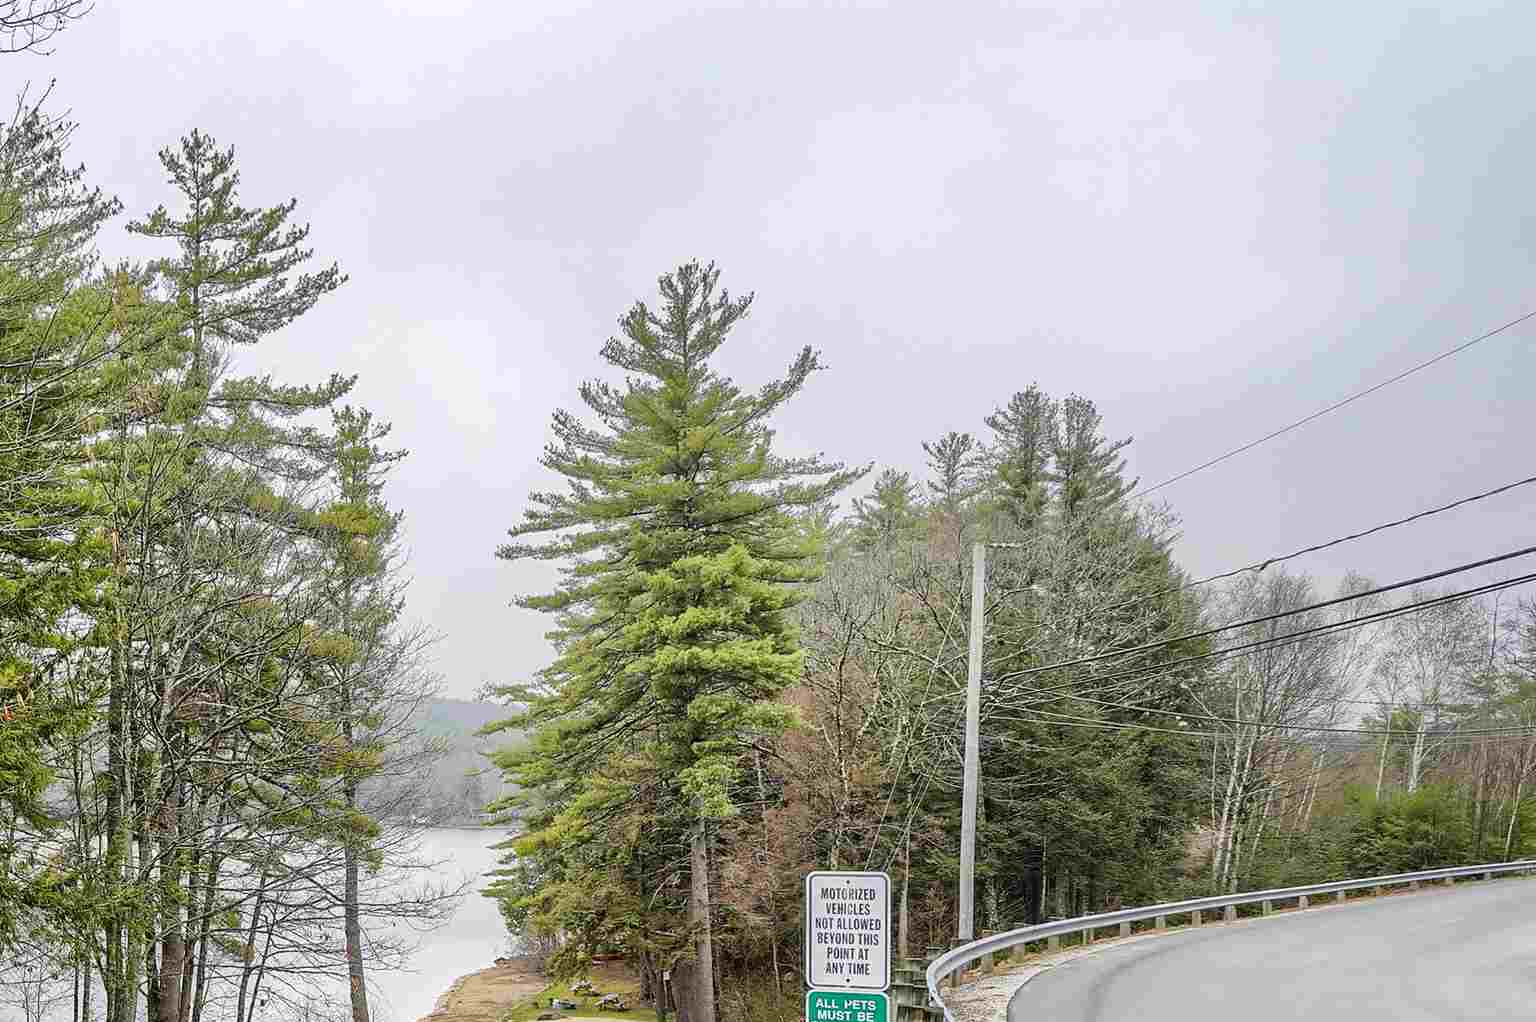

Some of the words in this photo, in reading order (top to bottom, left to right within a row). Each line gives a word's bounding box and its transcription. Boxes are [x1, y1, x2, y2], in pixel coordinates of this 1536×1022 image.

[820, 888, 876, 900] MOTORIZED
[826, 903, 871, 915] VEHICLES
[815, 918, 834, 929] NOT
[837, 918, 881, 930] ALLOWED
[817, 932, 854, 944] BEYOND
[858, 934, 879, 945] THIS
[827, 947, 856, 959] POINT
[858, 948, 870, 960] AT
[825, 962, 845, 975] ANY
[847, 963, 871, 975] TIME
[816, 998, 838, 1008] ALL
[844, 1000, 876, 1011] PETS
[817, 1010, 851, 1021] MUST
[857, 1012, 874, 1022] BE
